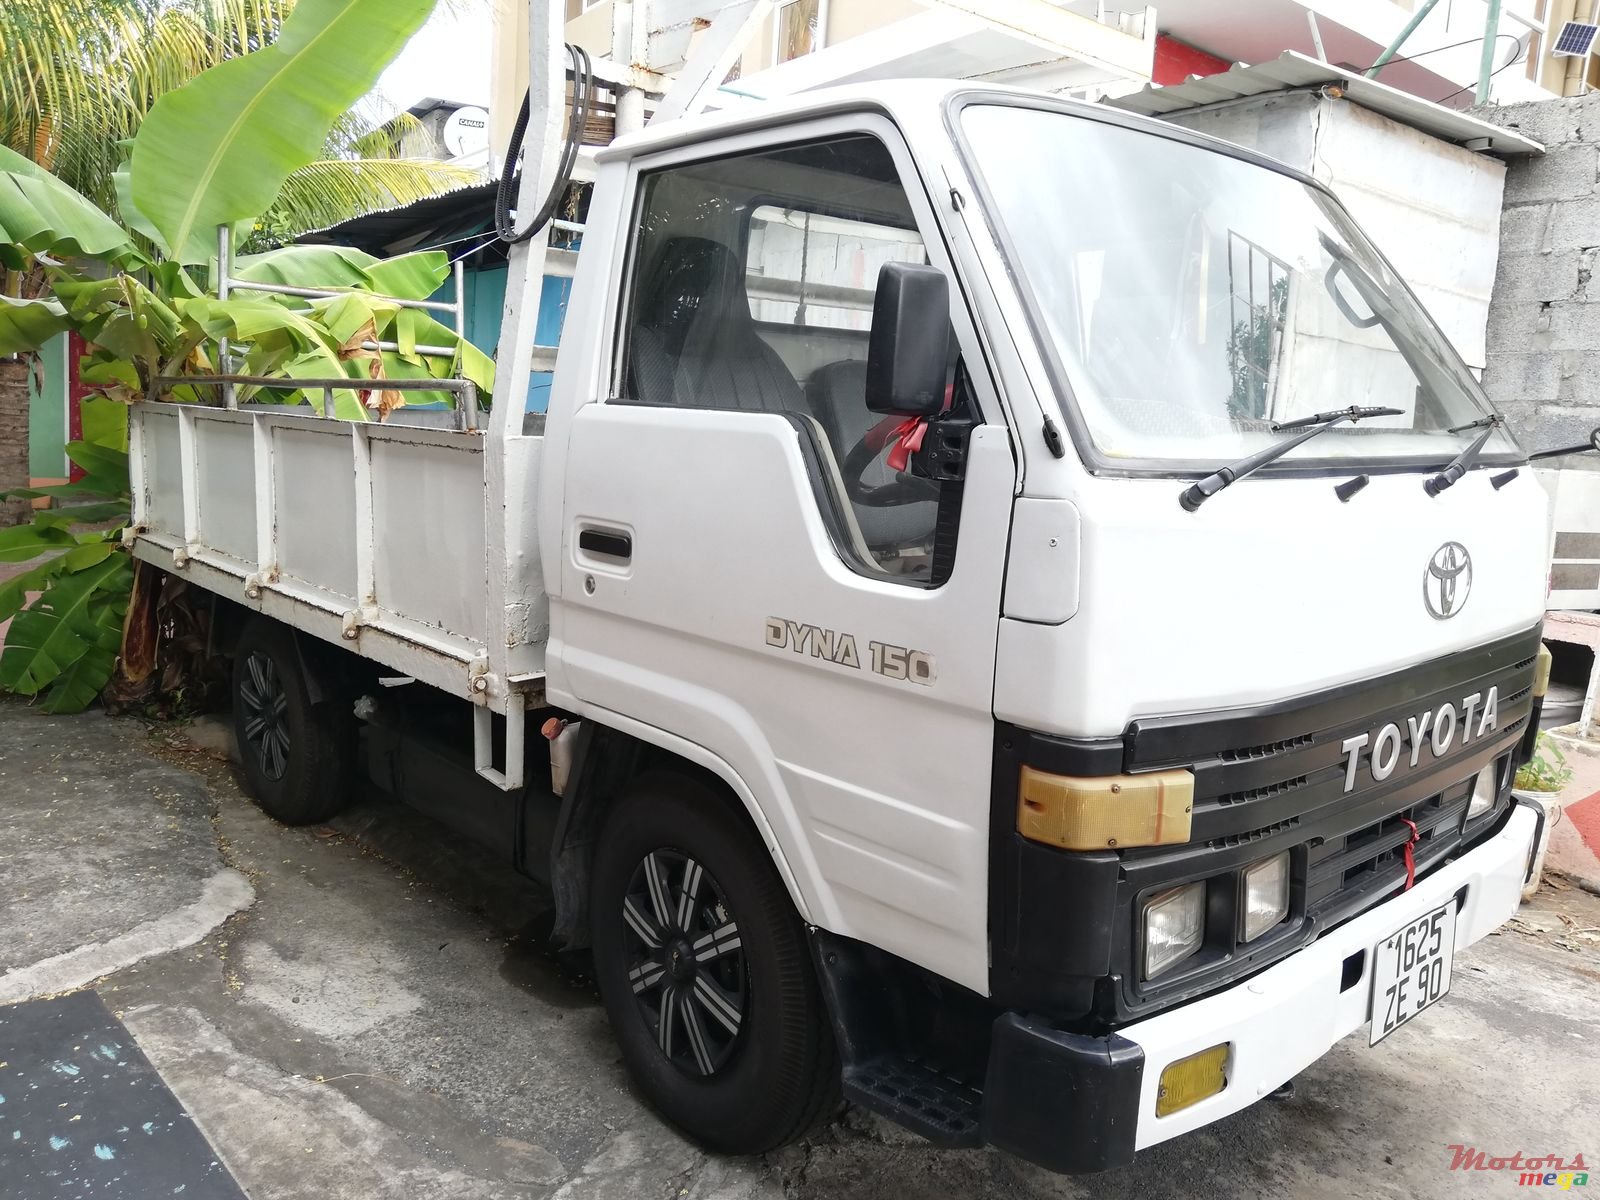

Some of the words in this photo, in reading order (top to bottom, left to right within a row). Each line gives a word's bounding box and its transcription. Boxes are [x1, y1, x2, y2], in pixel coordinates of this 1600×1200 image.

[459, 118, 484, 128] CANAL+
[765, 616, 861, 669] DYNA
[868, 640, 937, 687] 150
[1341, 685, 1499, 793] TOYOTA
[1394, 909, 1447, 978] 1625
[1383, 975, 1410, 1033] ZE
[1416, 956, 1443, 1009] 90
